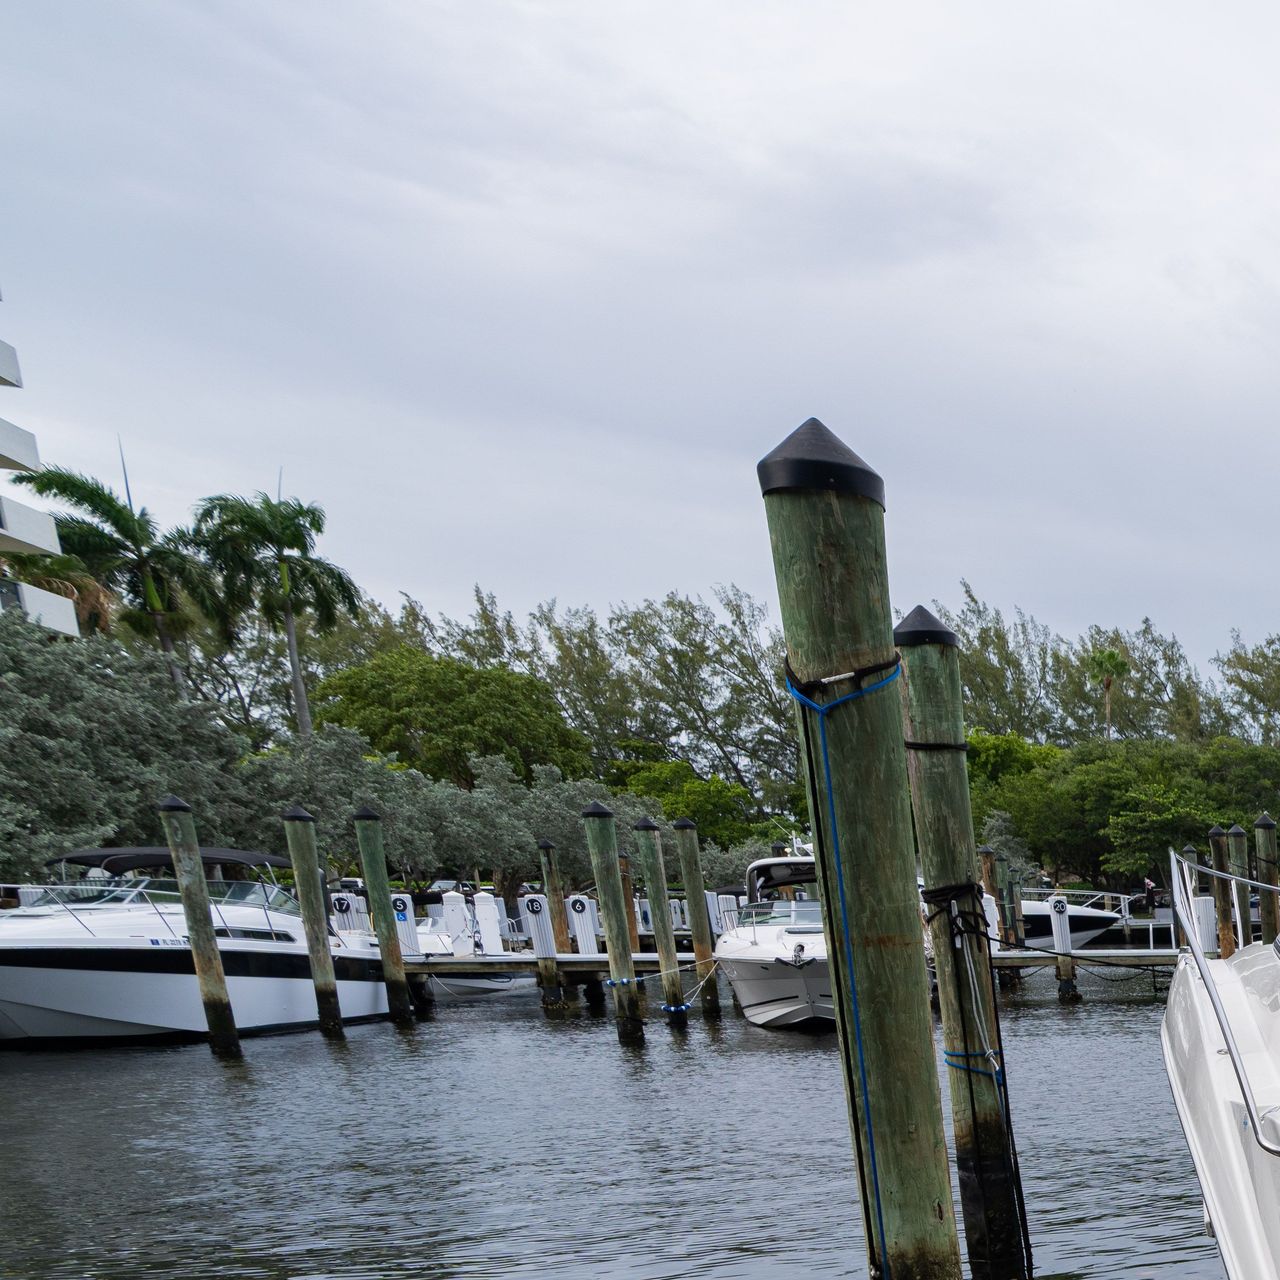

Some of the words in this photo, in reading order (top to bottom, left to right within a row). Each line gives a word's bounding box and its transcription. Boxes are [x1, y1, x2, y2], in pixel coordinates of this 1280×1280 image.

[334, 900, 348, 910] 17
[396, 901, 404, 910] 5
[528, 902, 541, 911] 18
[575, 902, 582, 911] 6
[1054, 902, 1066, 911] 20
